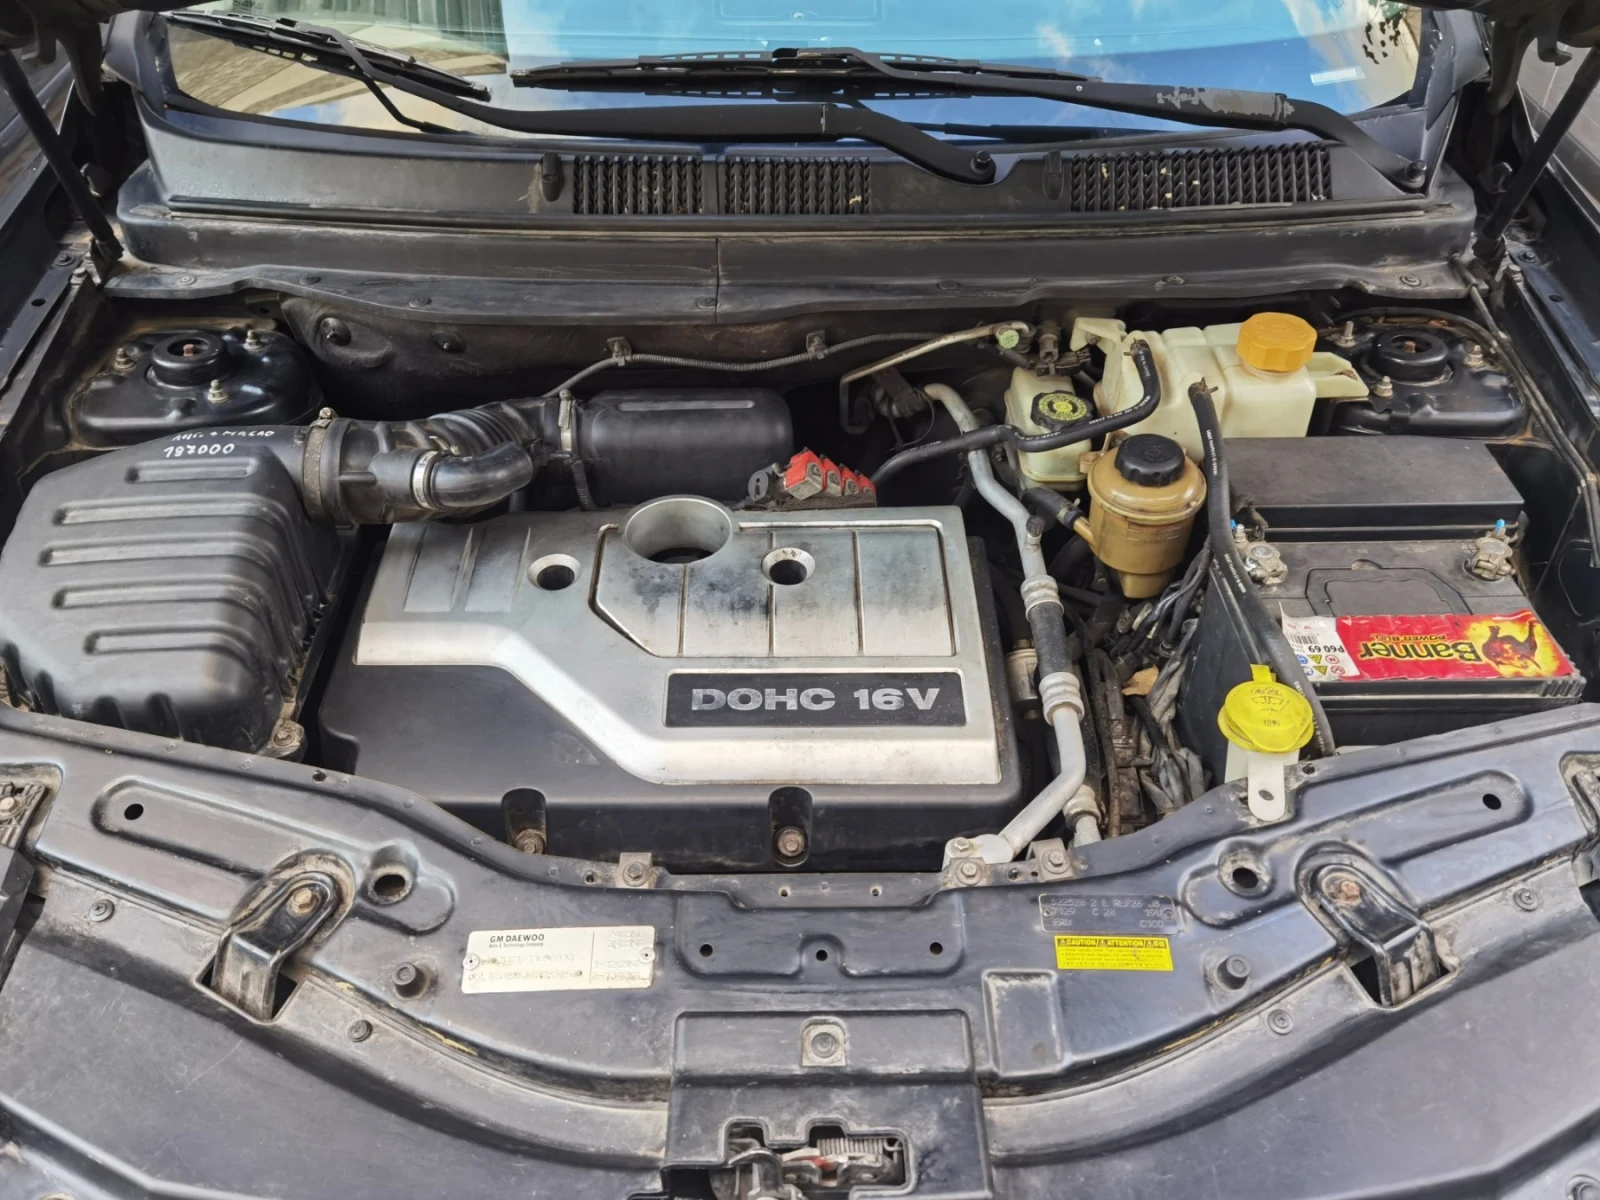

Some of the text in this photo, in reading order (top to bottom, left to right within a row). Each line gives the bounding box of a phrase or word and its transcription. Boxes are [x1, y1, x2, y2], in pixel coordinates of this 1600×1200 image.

[1399, 634, 1447, 642] POWER
[1308, 645, 1321, 653] 69
[1323, 644, 1345, 653] P60
[1358, 641, 1482, 663] Banner
[691, 687, 941, 711] DOHC 16V
[489, 933, 545, 943] GM DAEWOO
